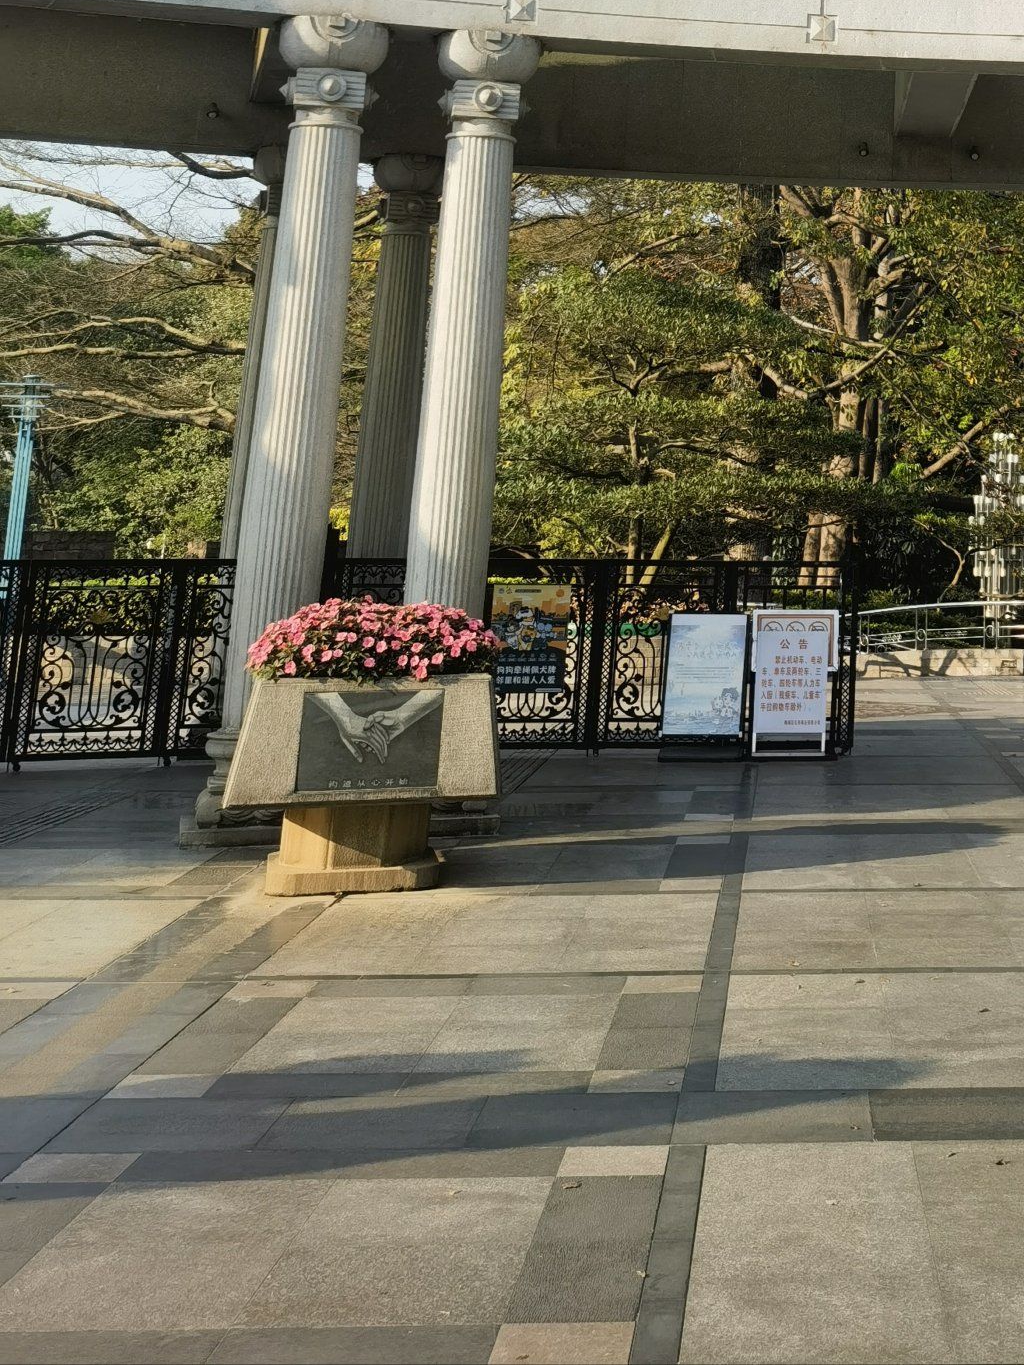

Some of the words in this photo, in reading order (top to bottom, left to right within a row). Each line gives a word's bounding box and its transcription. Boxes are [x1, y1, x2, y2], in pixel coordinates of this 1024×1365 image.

[780, 638, 808, 650] 公告
[496, 676, 556, 685] 邻里和谐人人爱
